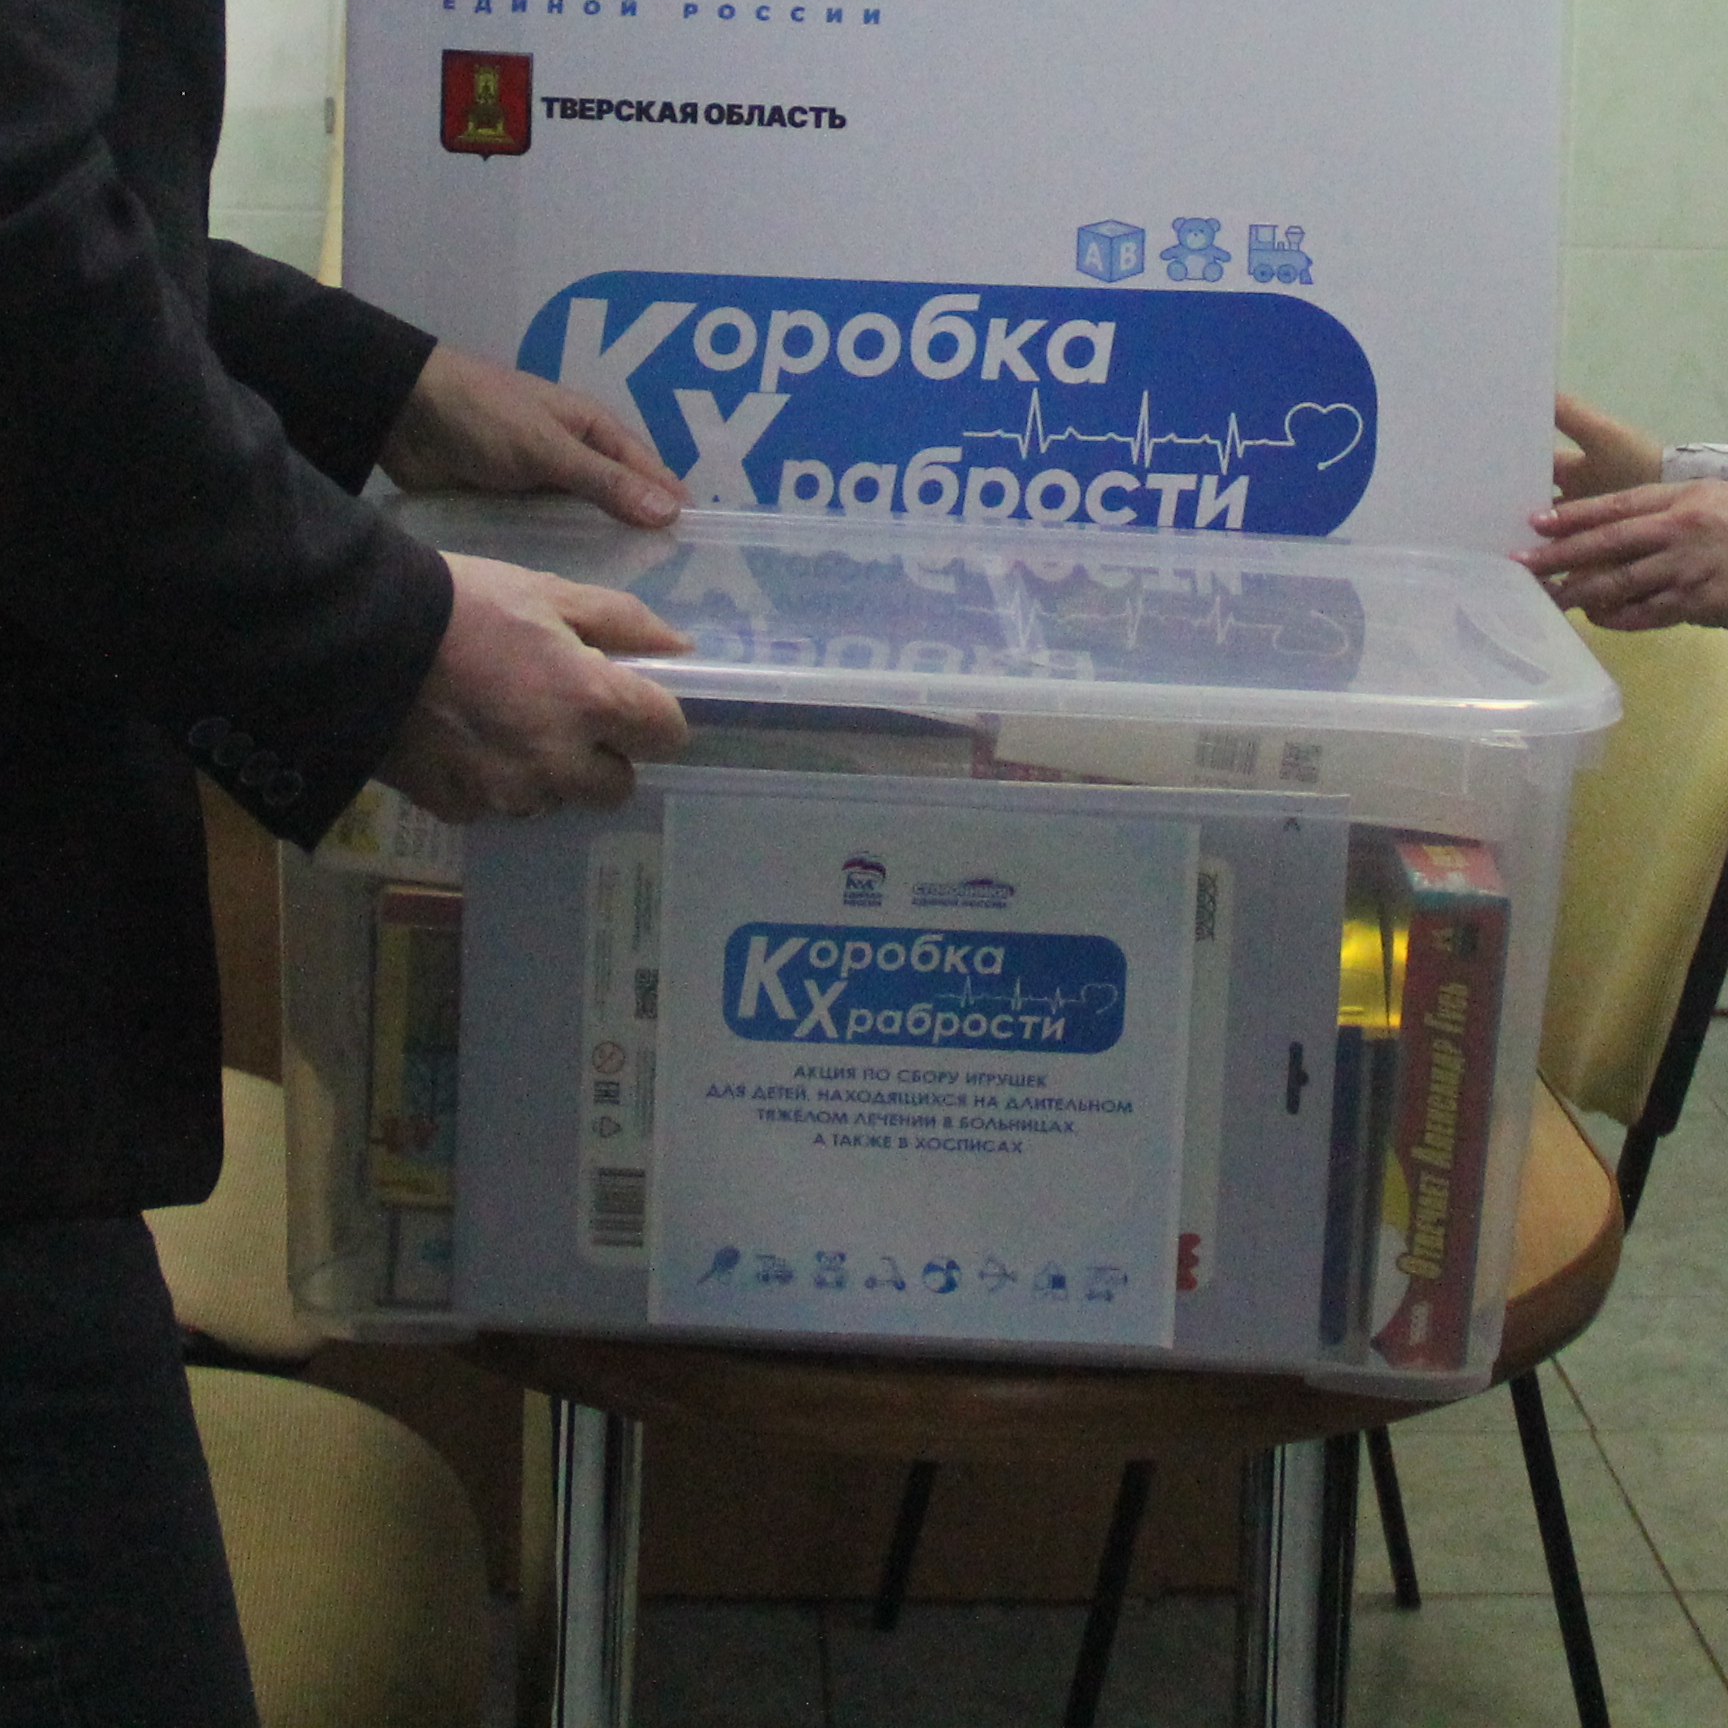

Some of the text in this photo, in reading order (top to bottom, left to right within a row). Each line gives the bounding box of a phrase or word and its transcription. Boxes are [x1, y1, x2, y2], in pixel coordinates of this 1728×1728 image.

[683, 2, 881, 26] РОССИИ
[540, 95, 847, 129] ТВЕРСКАЯ ОБЛАСТЬ
[557, 292, 1116, 476] Коробка
[673, 388, 1251, 532] Храбрости
[738, 934, 1005, 1019] Коробка
[793, 979, 1066, 1045] Храбрости
[705, 1083, 746, 1100] ДЛЯ
[974, 1093, 1000, 1109] НА
[793, 1065, 856, 1083] АКЦИЯ
[897, 1069, 959, 1085] СБОРУ
[965, 1072, 1047, 1088] ИГРУШЕК
